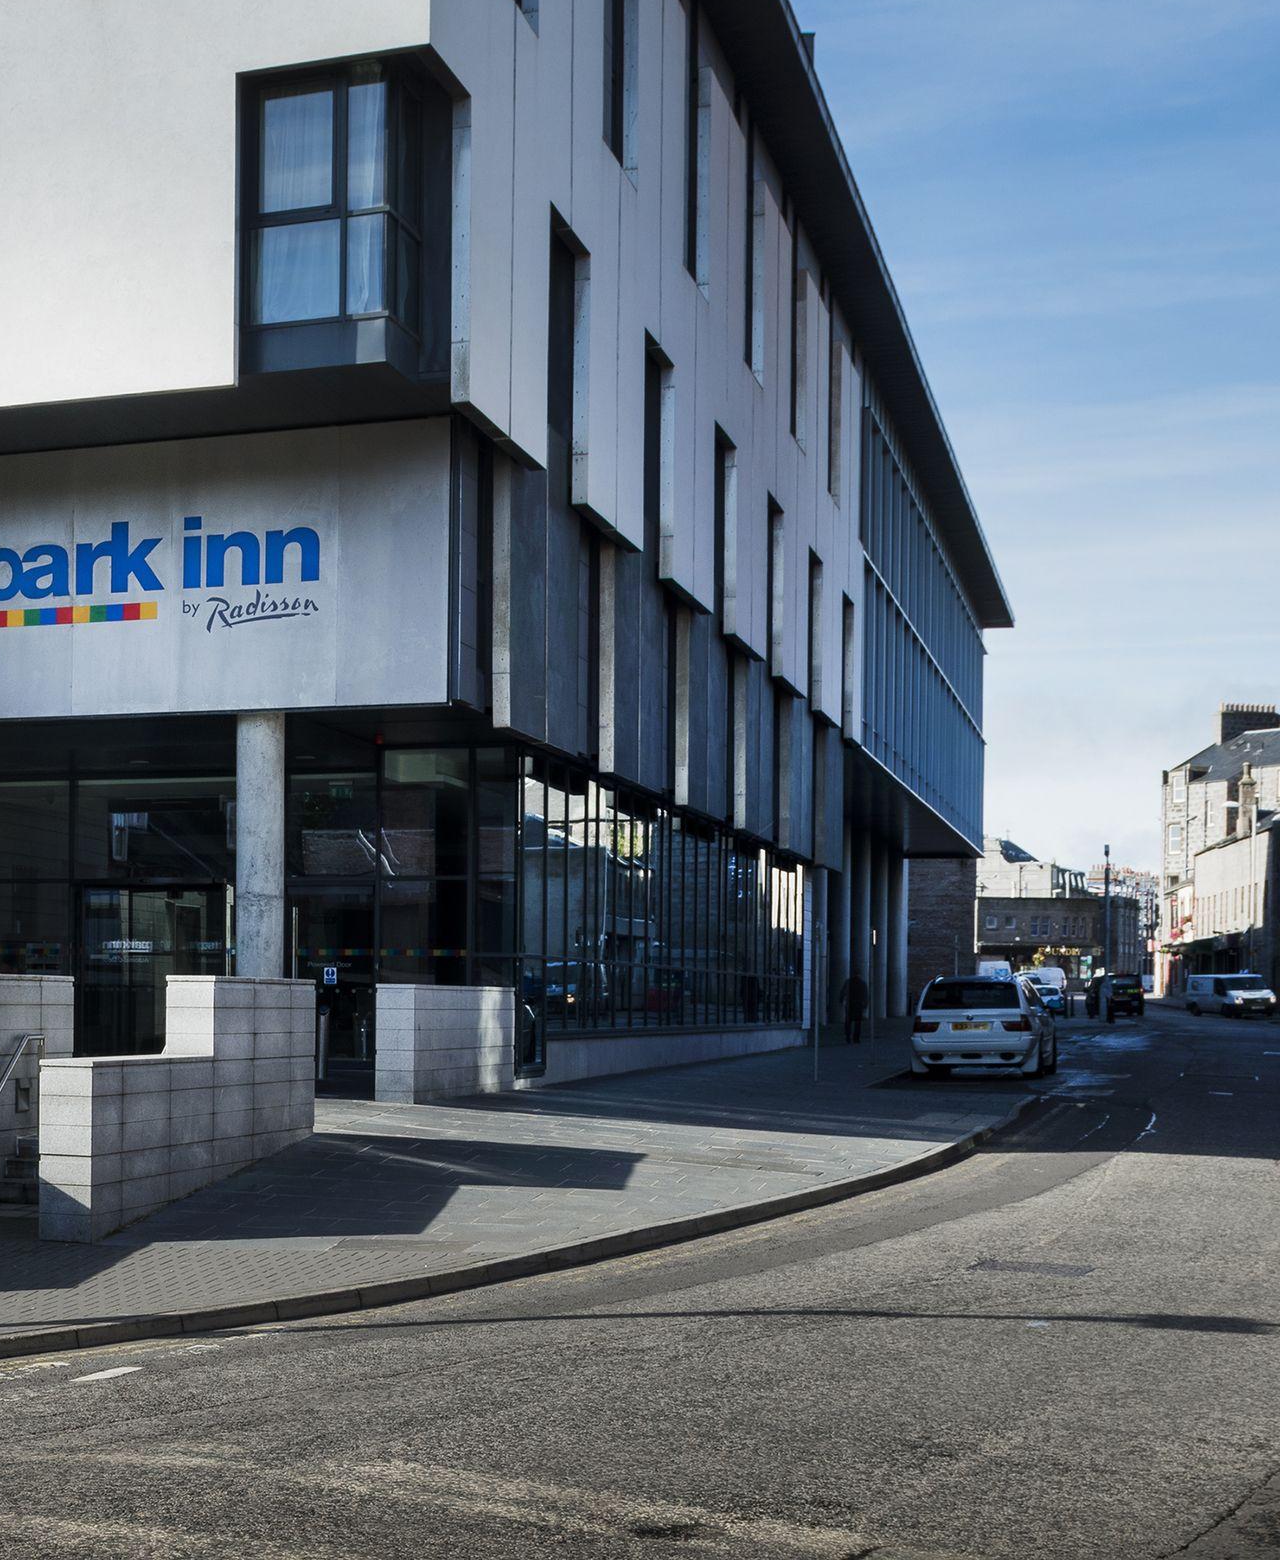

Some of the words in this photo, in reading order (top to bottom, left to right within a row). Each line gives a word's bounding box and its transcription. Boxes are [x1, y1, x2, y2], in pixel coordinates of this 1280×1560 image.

[183, 516, 320, 589] inn
[182, 599, 200, 618] by
[206, 589, 319, 633] Radisson
